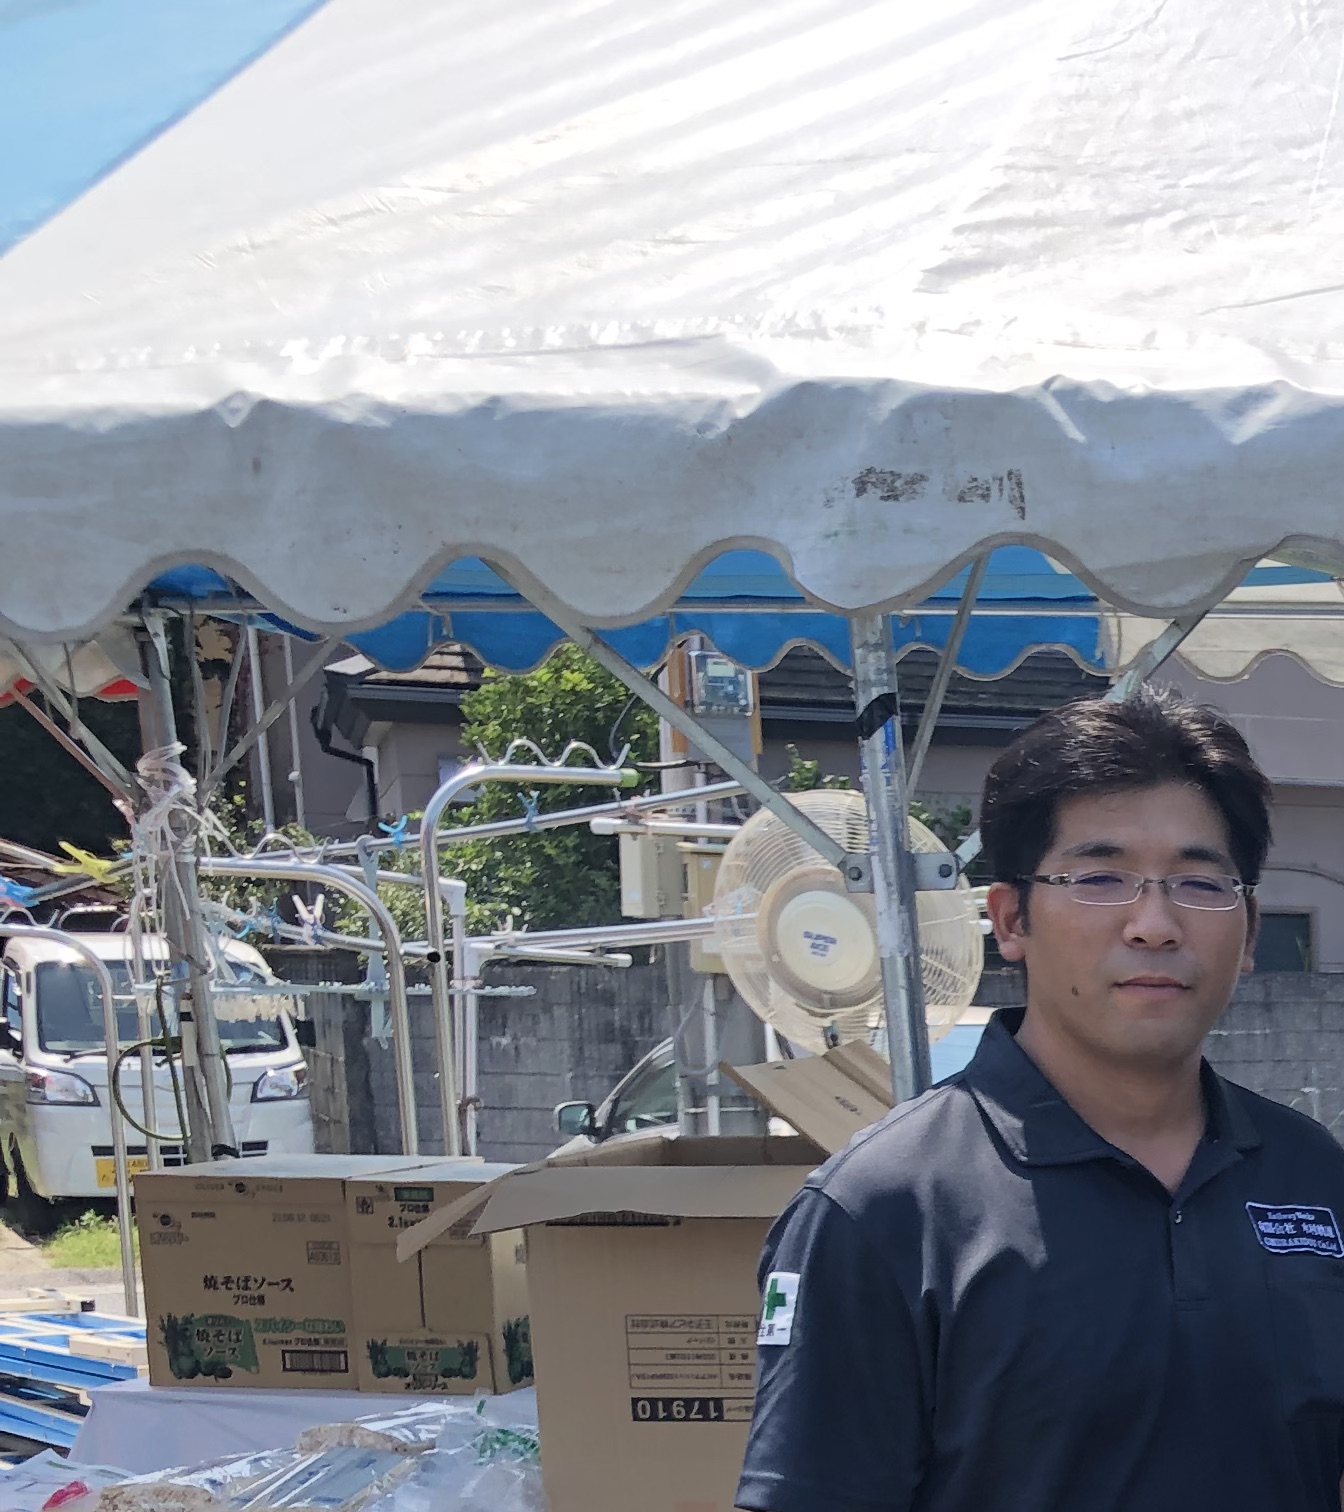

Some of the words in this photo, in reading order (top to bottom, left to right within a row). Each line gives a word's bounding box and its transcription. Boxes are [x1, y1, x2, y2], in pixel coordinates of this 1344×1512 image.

[203, 1274, 295, 1293] 焼そばソース
[636, 1399, 720, 1420] 17910
